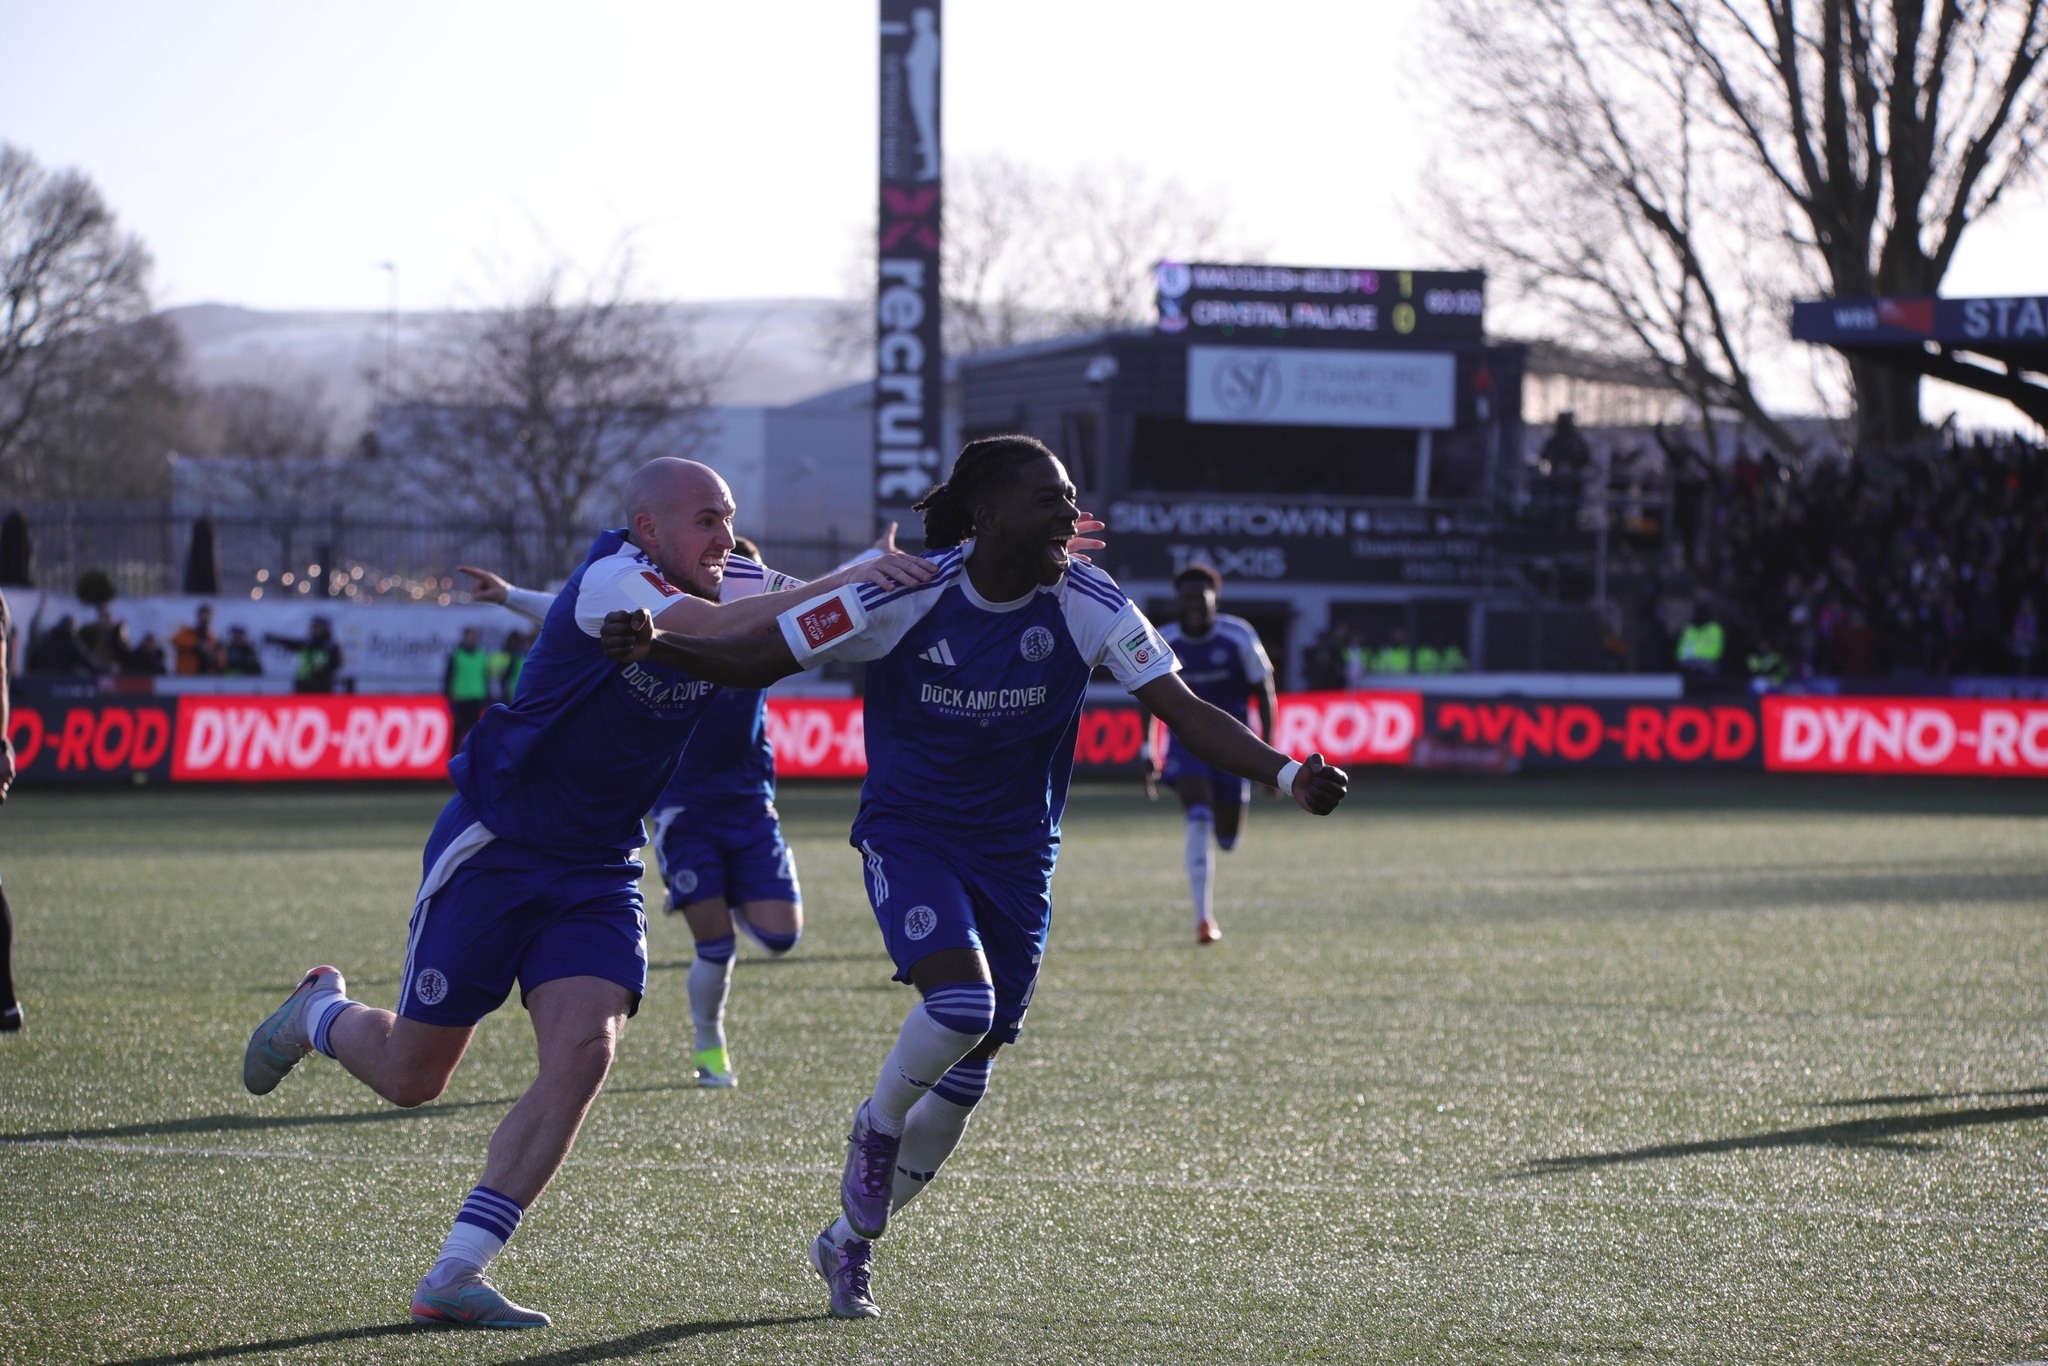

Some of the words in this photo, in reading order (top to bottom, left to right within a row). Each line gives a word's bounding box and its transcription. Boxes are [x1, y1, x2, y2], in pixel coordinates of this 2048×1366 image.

[1191, 299, 1290, 329] CRYSTAL
[1292, 302, 1379, 331] PALACE
[1392, 301, 1416, 335] 0
[878, 258, 940, 499] recruit
[1108, 501, 1347, 537] SILVERTOWN
[1167, 544, 1288, 579] TAXIS
[965, 690, 998, 710] AND
[999, 686, 1047, 709] COVER
[185, 706, 450, 770] DYNO-ROD
